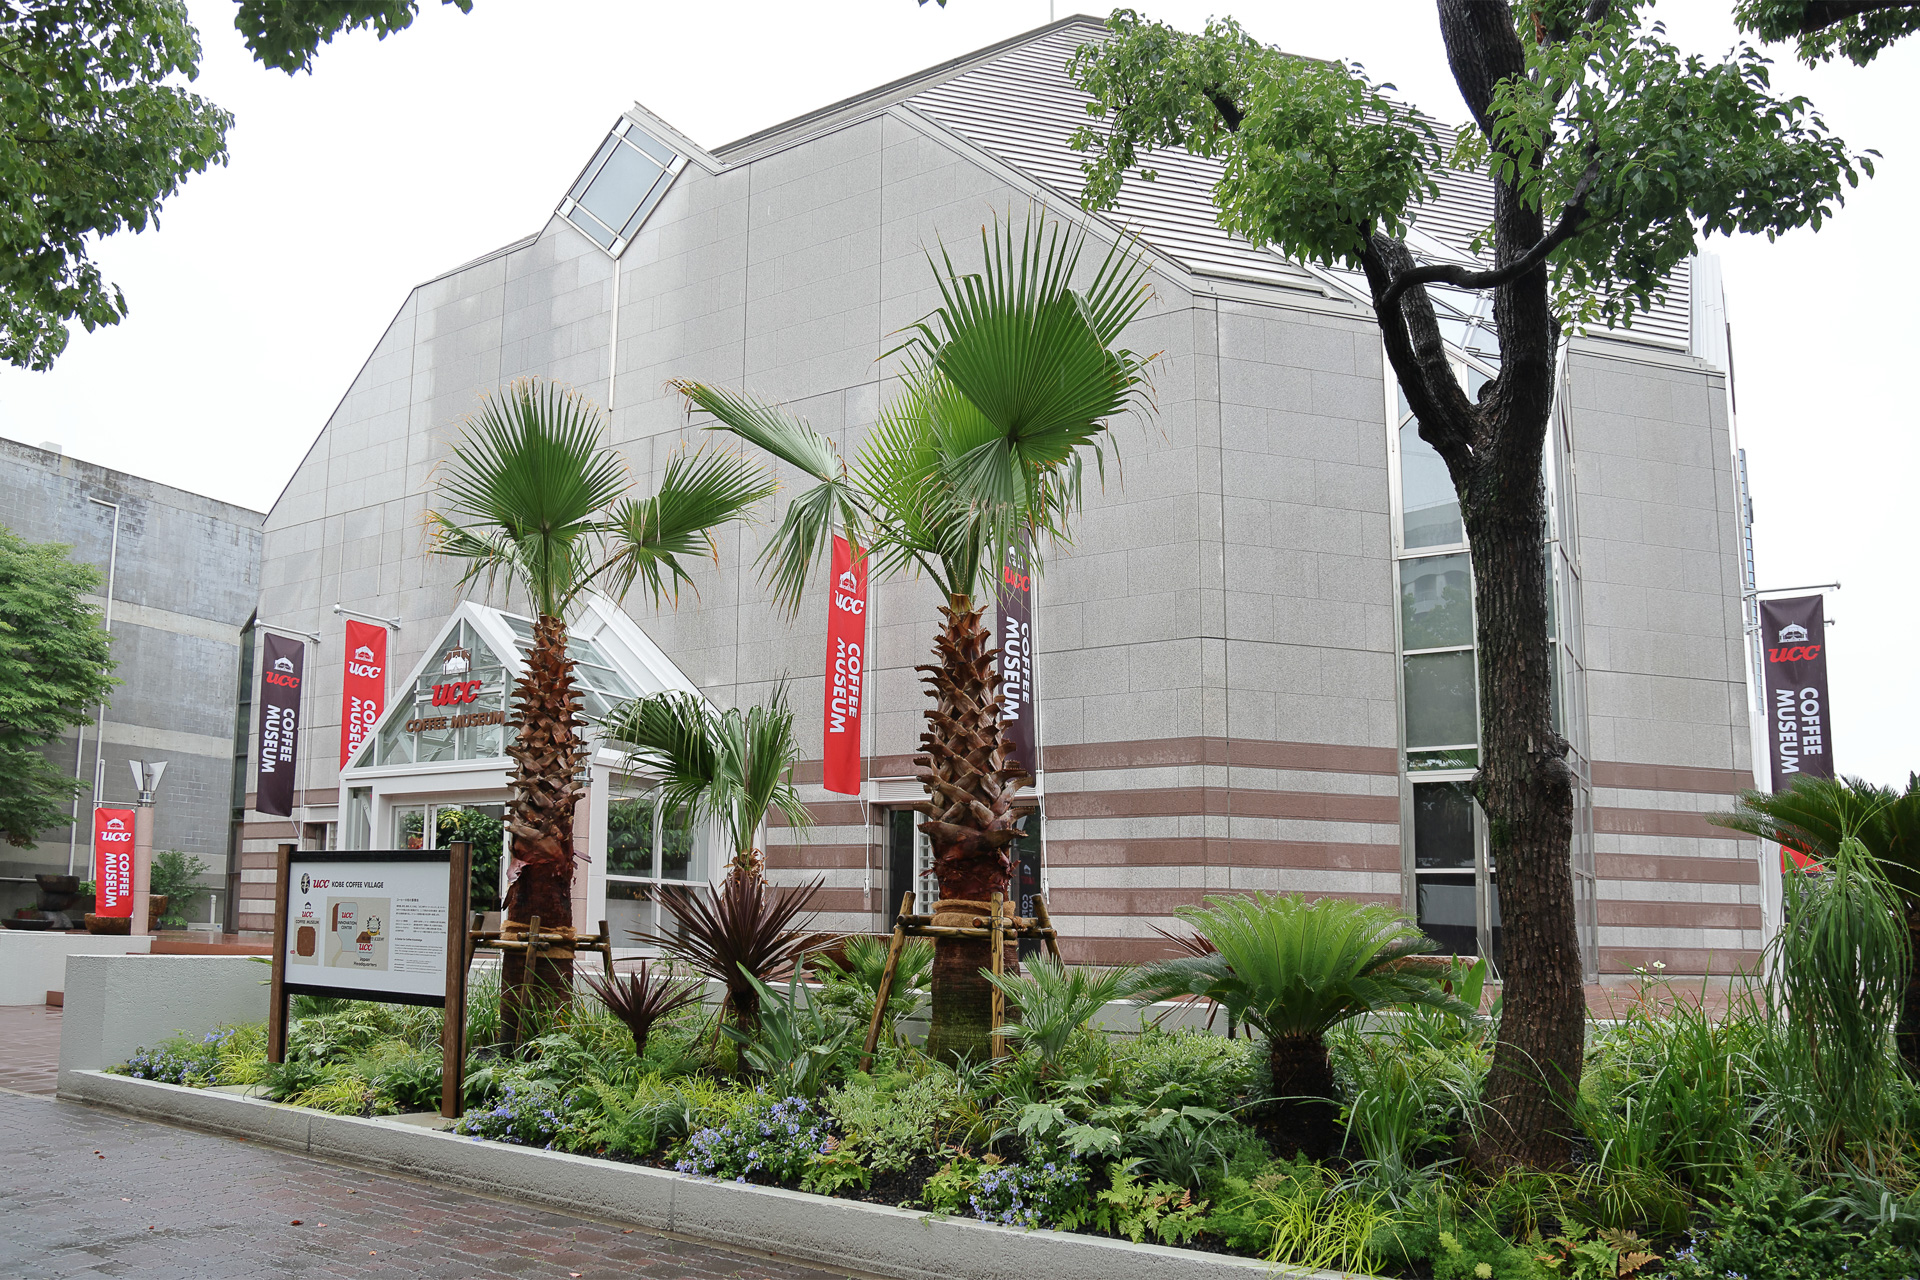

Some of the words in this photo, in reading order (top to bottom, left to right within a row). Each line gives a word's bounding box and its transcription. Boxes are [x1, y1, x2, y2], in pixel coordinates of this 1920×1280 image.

[835, 590, 864, 615] UCC
[349, 661, 381, 679] UCC
[1003, 616, 1021, 720] MUSEUM
[1021, 622, 1030, 704] COFFEE
[1768, 644, 1821, 663] UCC
[266, 671, 300, 689] UCC
[431, 680, 483, 707] UCC
[829, 637, 847, 733] MUSEUM
[848, 643, 861, 718] COFFEE
[261, 704, 281, 773] MUSEUM
[279, 708, 295, 763] COFFEE
[405, 716, 448, 733] COFFEE
[450, 711, 506, 728] MUSEUM
[1776, 689, 1800, 774] MUSEUM
[1800, 687, 1823, 756] COFFEE
[101, 831, 131, 842] UCC
[105, 852, 117, 908] MUSEUM
[119, 853, 130, 896] COFFEE
[312, 879, 330, 889] UCC
[345, 881, 363, 889] COFFEE
[363, 881, 384, 889] VILLAGE
